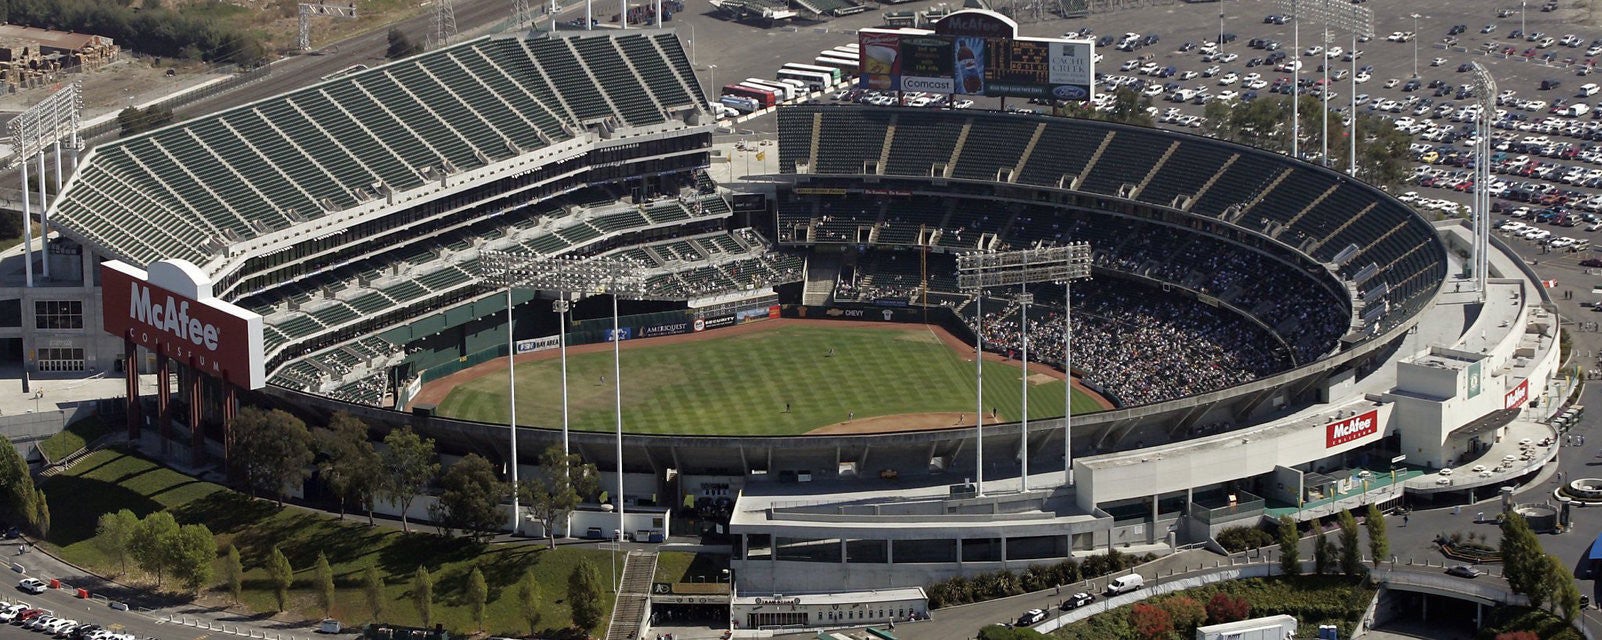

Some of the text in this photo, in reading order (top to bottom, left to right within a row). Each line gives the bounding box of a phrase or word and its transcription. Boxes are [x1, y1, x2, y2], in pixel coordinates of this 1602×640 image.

[948, 17, 999, 32] McAfee
[1052, 65, 1085, 73] CREEK
[904, 77, 949, 91] comcast
[130, 281, 219, 351] McAfee
[845, 309, 864, 317] CHEVY
[705, 316, 735, 325] SECURITY
[646, 323, 688, 333] AMERIQUEST
[129, 327, 220, 372] COLISEUM
[546, 339, 559, 347] AREA
[1506, 386, 1526, 409] McAfee
[1333, 417, 1372, 439] McAfee
